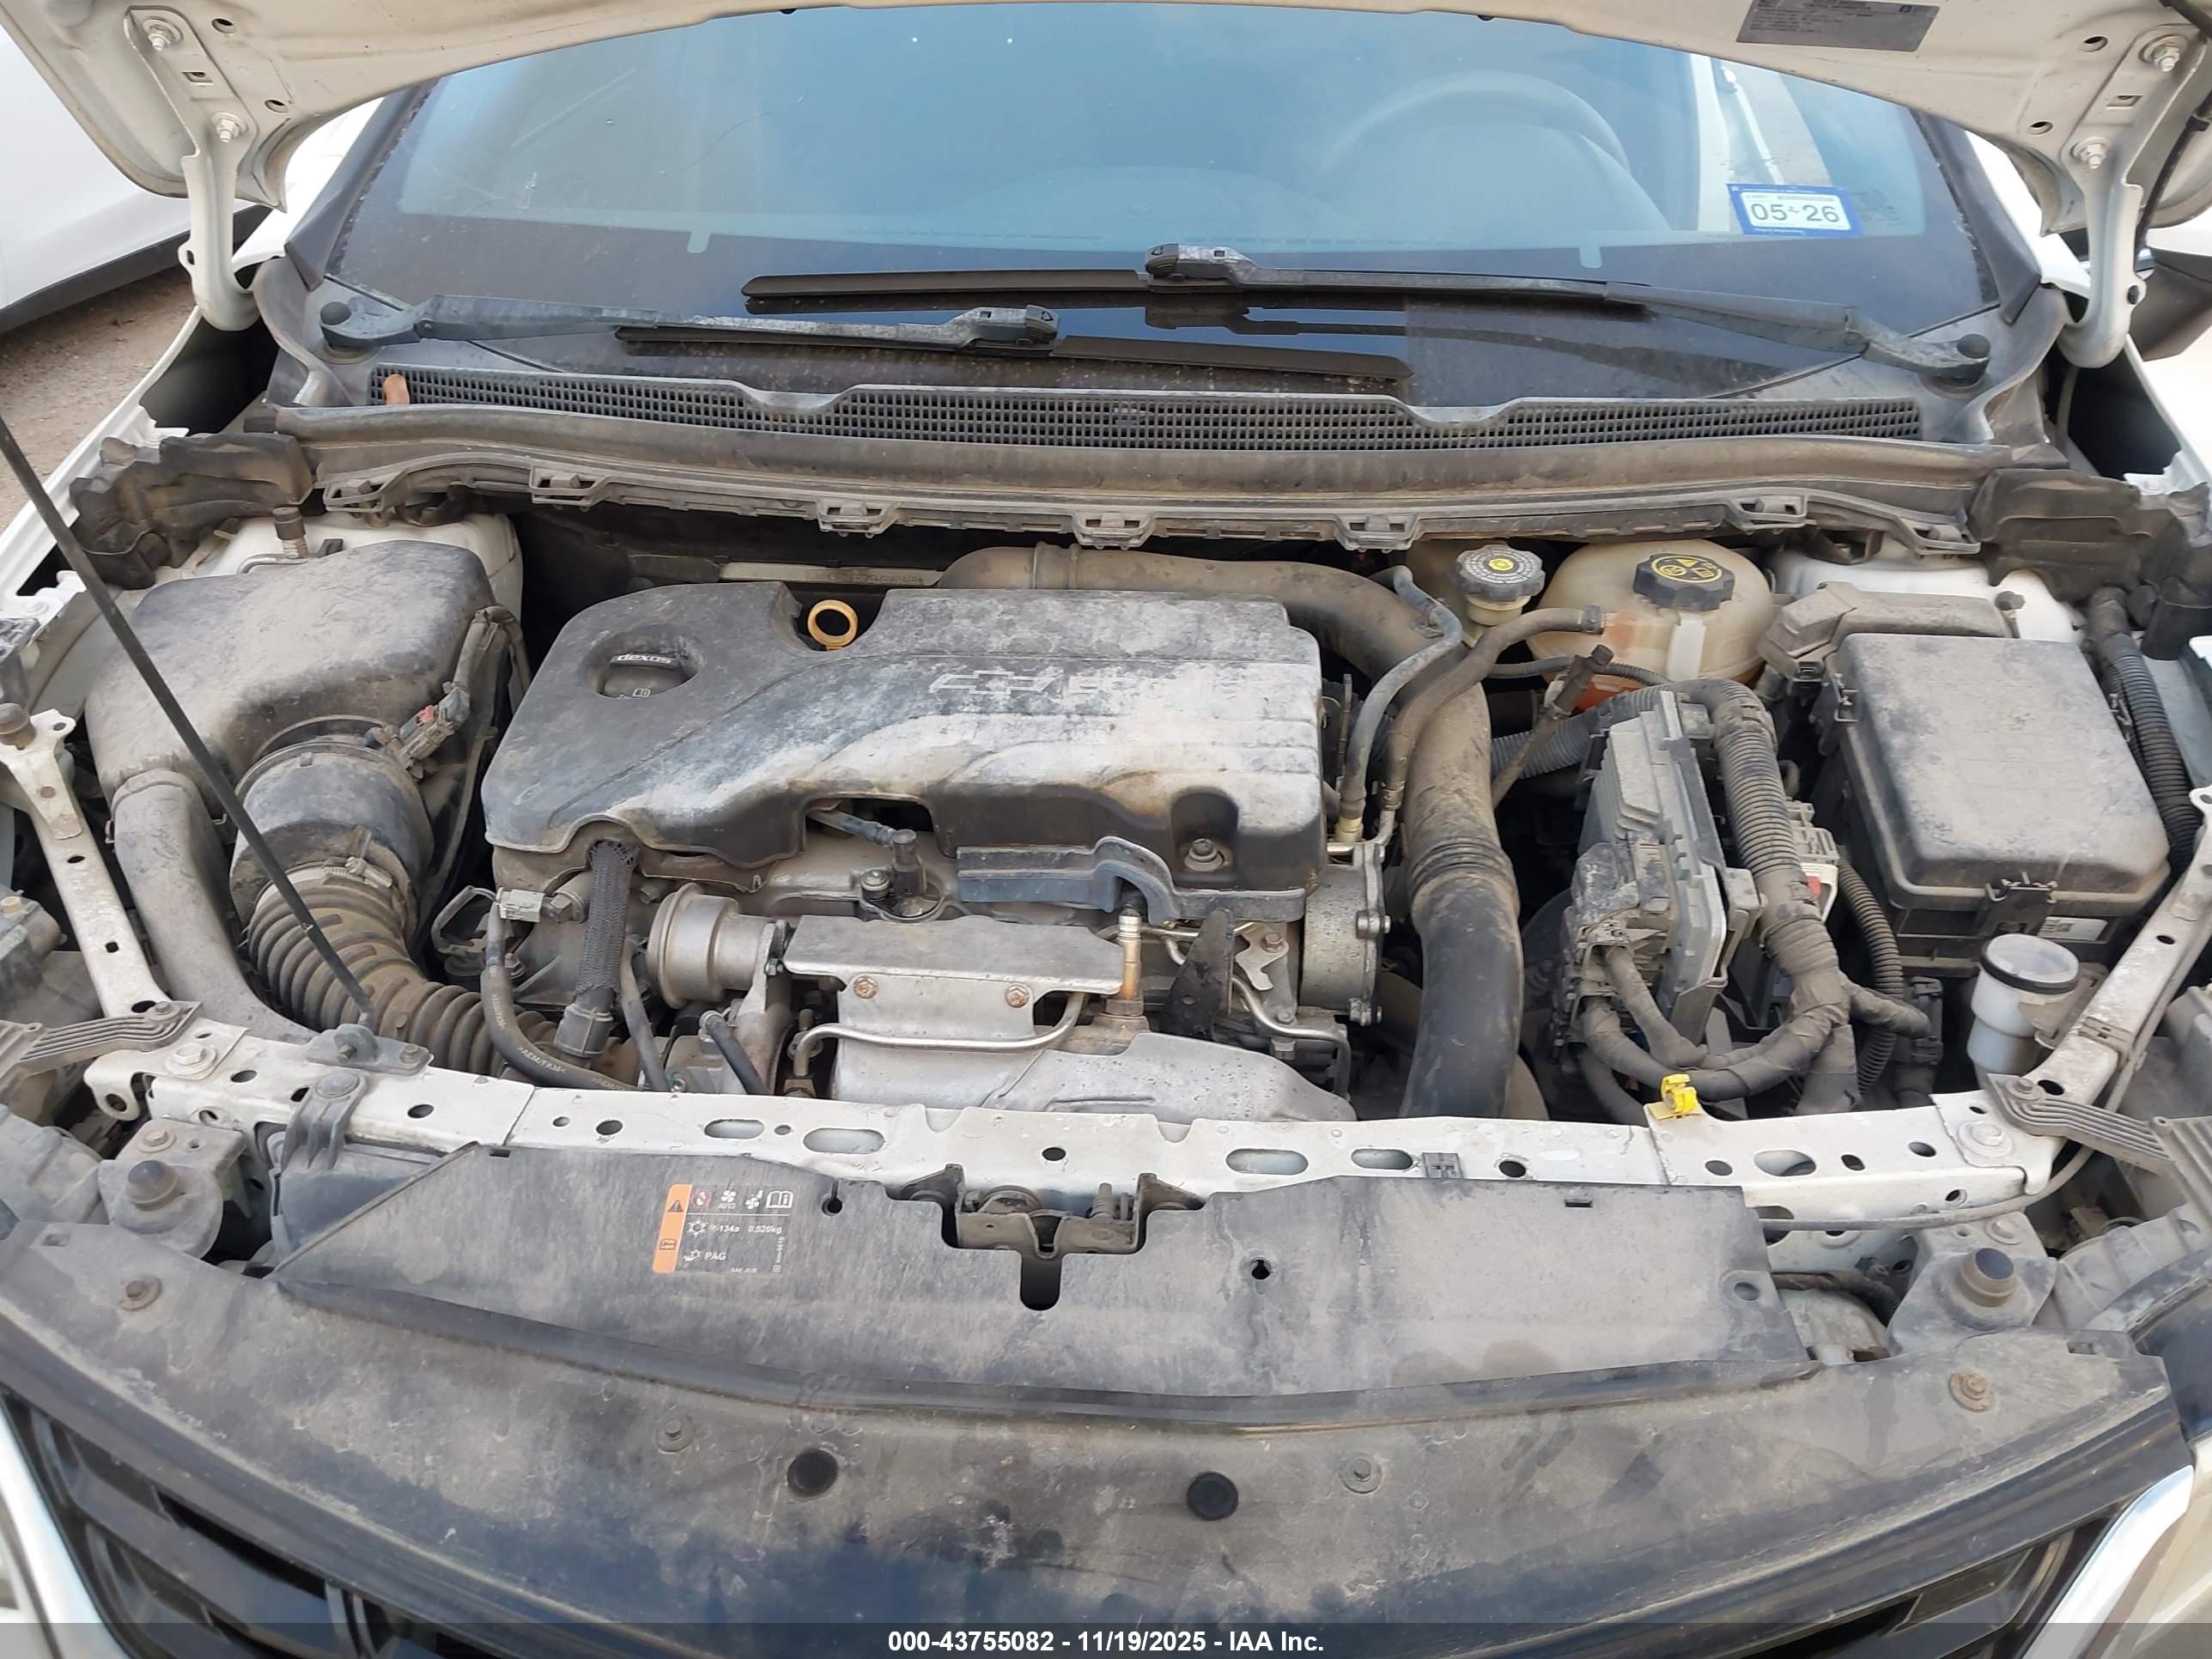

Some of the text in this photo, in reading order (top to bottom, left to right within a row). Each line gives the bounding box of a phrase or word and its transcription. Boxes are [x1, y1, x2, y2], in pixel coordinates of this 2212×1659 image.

[1751, 203, 1788, 222] 05
[1802, 204, 1839, 223] 26
[617, 653, 673, 664] dexos
[703, 1251, 727, 1261] PAG
